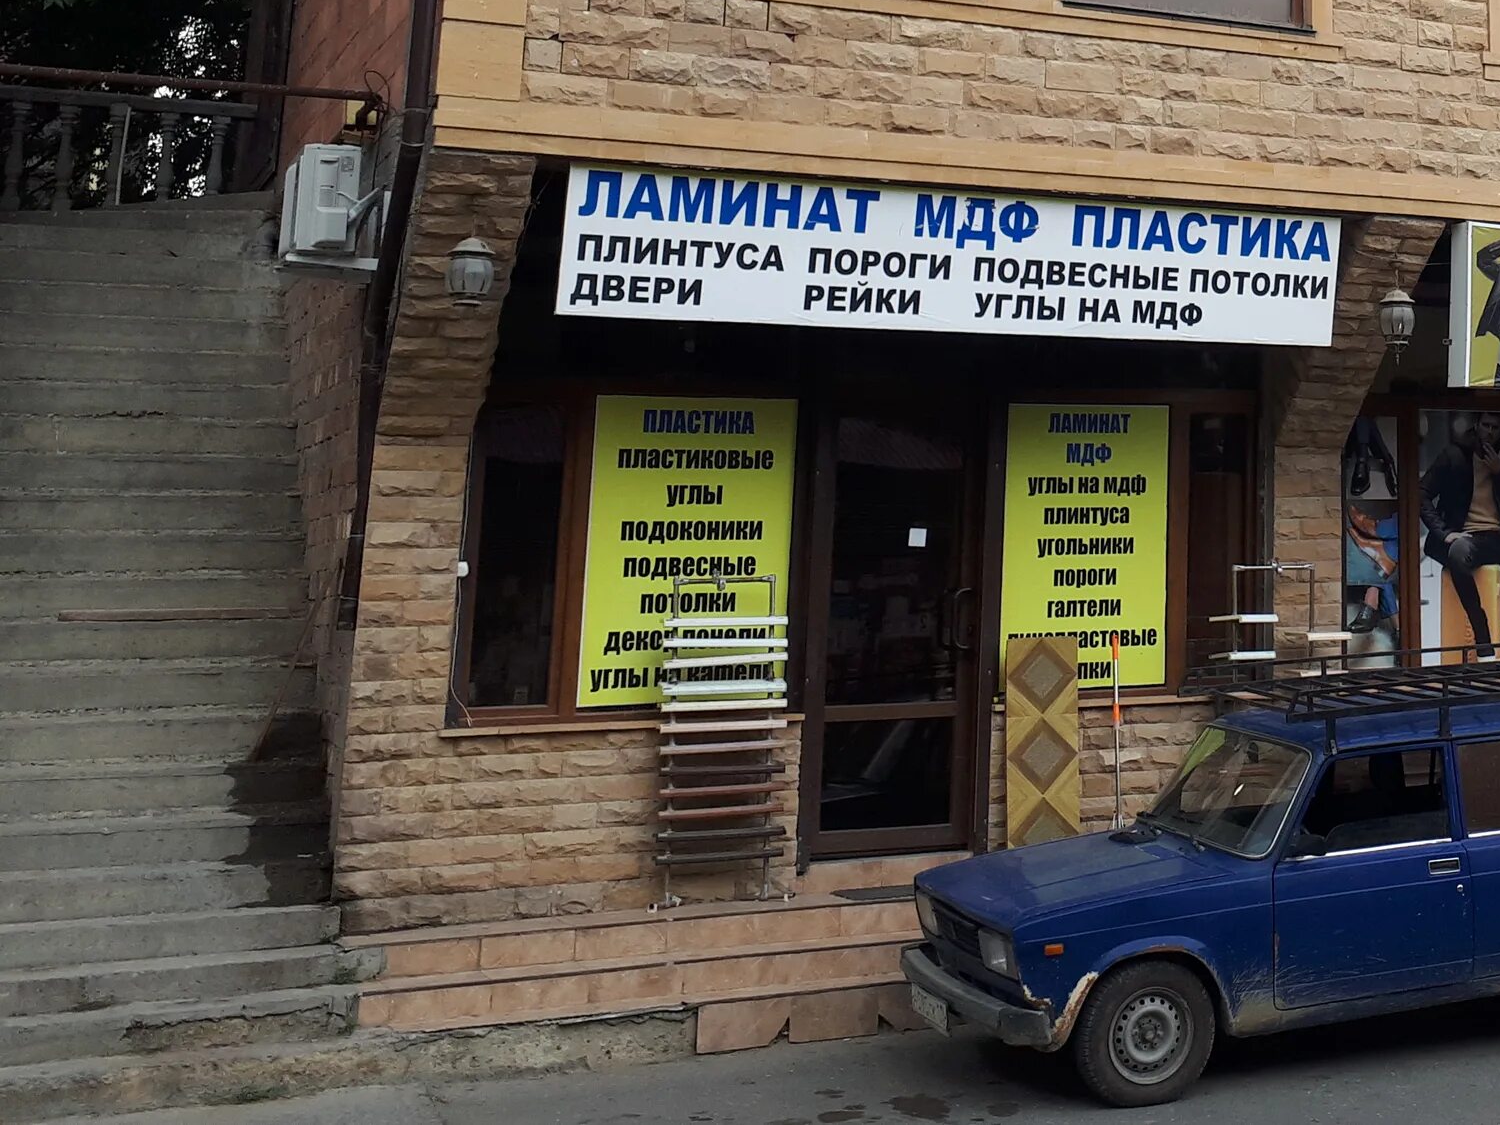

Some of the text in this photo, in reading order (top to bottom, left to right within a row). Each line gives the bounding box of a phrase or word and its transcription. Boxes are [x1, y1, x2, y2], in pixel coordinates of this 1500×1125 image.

[579, 169, 1332, 262] ЛАМИНАТ МДФ ПЛАСТИКА
[575, 233, 1330, 300] ПЛИНТУСА ПОРОГИ ПОДВЕСНЫЕ ПОТОЛКИ
[569, 273, 1204, 328] ДВЕРИ РЕЙКИ УГЛЫ НА МДФ
[642, 408, 755, 435] ПЛАСТИКА
[1048, 412, 1131, 434] ЛАМИНАТ
[617, 446, 774, 471] пластиковые
[1065, 442, 1112, 464] МДФ
[666, 481, 724, 510] углы
[1026, 473, 1147, 497] углы на мдф
[1042, 503, 1130, 526] плинтуса
[620, 517, 764, 544] подоконики
[1036, 534, 1135, 558] угольники
[622, 554, 757, 581] подвесные
[1052, 565, 1118, 588] пороги
[639, 589, 737, 616] потолки
[1046, 596, 1122, 620] галтели
[589, 665, 649, 694] углы
